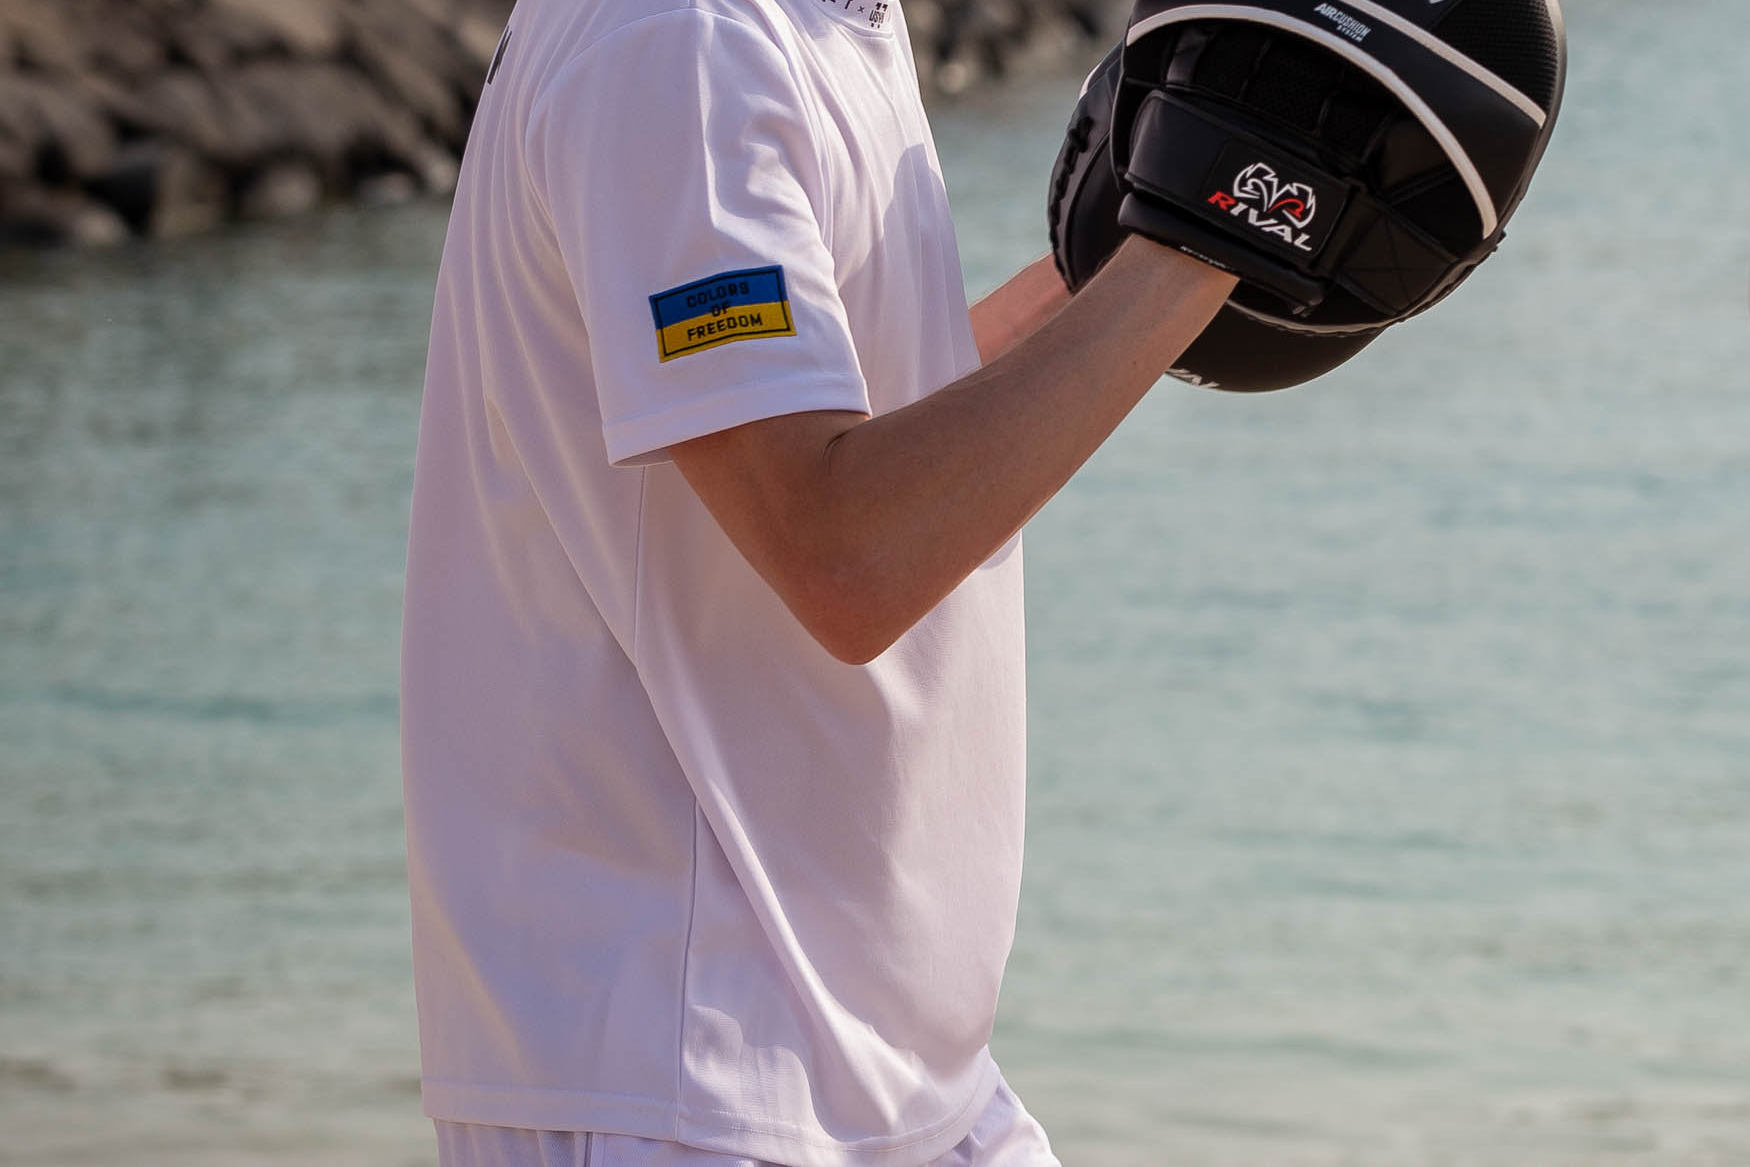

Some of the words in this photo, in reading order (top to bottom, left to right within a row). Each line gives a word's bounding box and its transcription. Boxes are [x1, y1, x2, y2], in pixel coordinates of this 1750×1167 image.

[1208, 190, 1312, 251] RIVAL
[687, 282, 750, 307] COLORS
[711, 301, 730, 317] OF
[687, 313, 763, 341] FREEDOM
